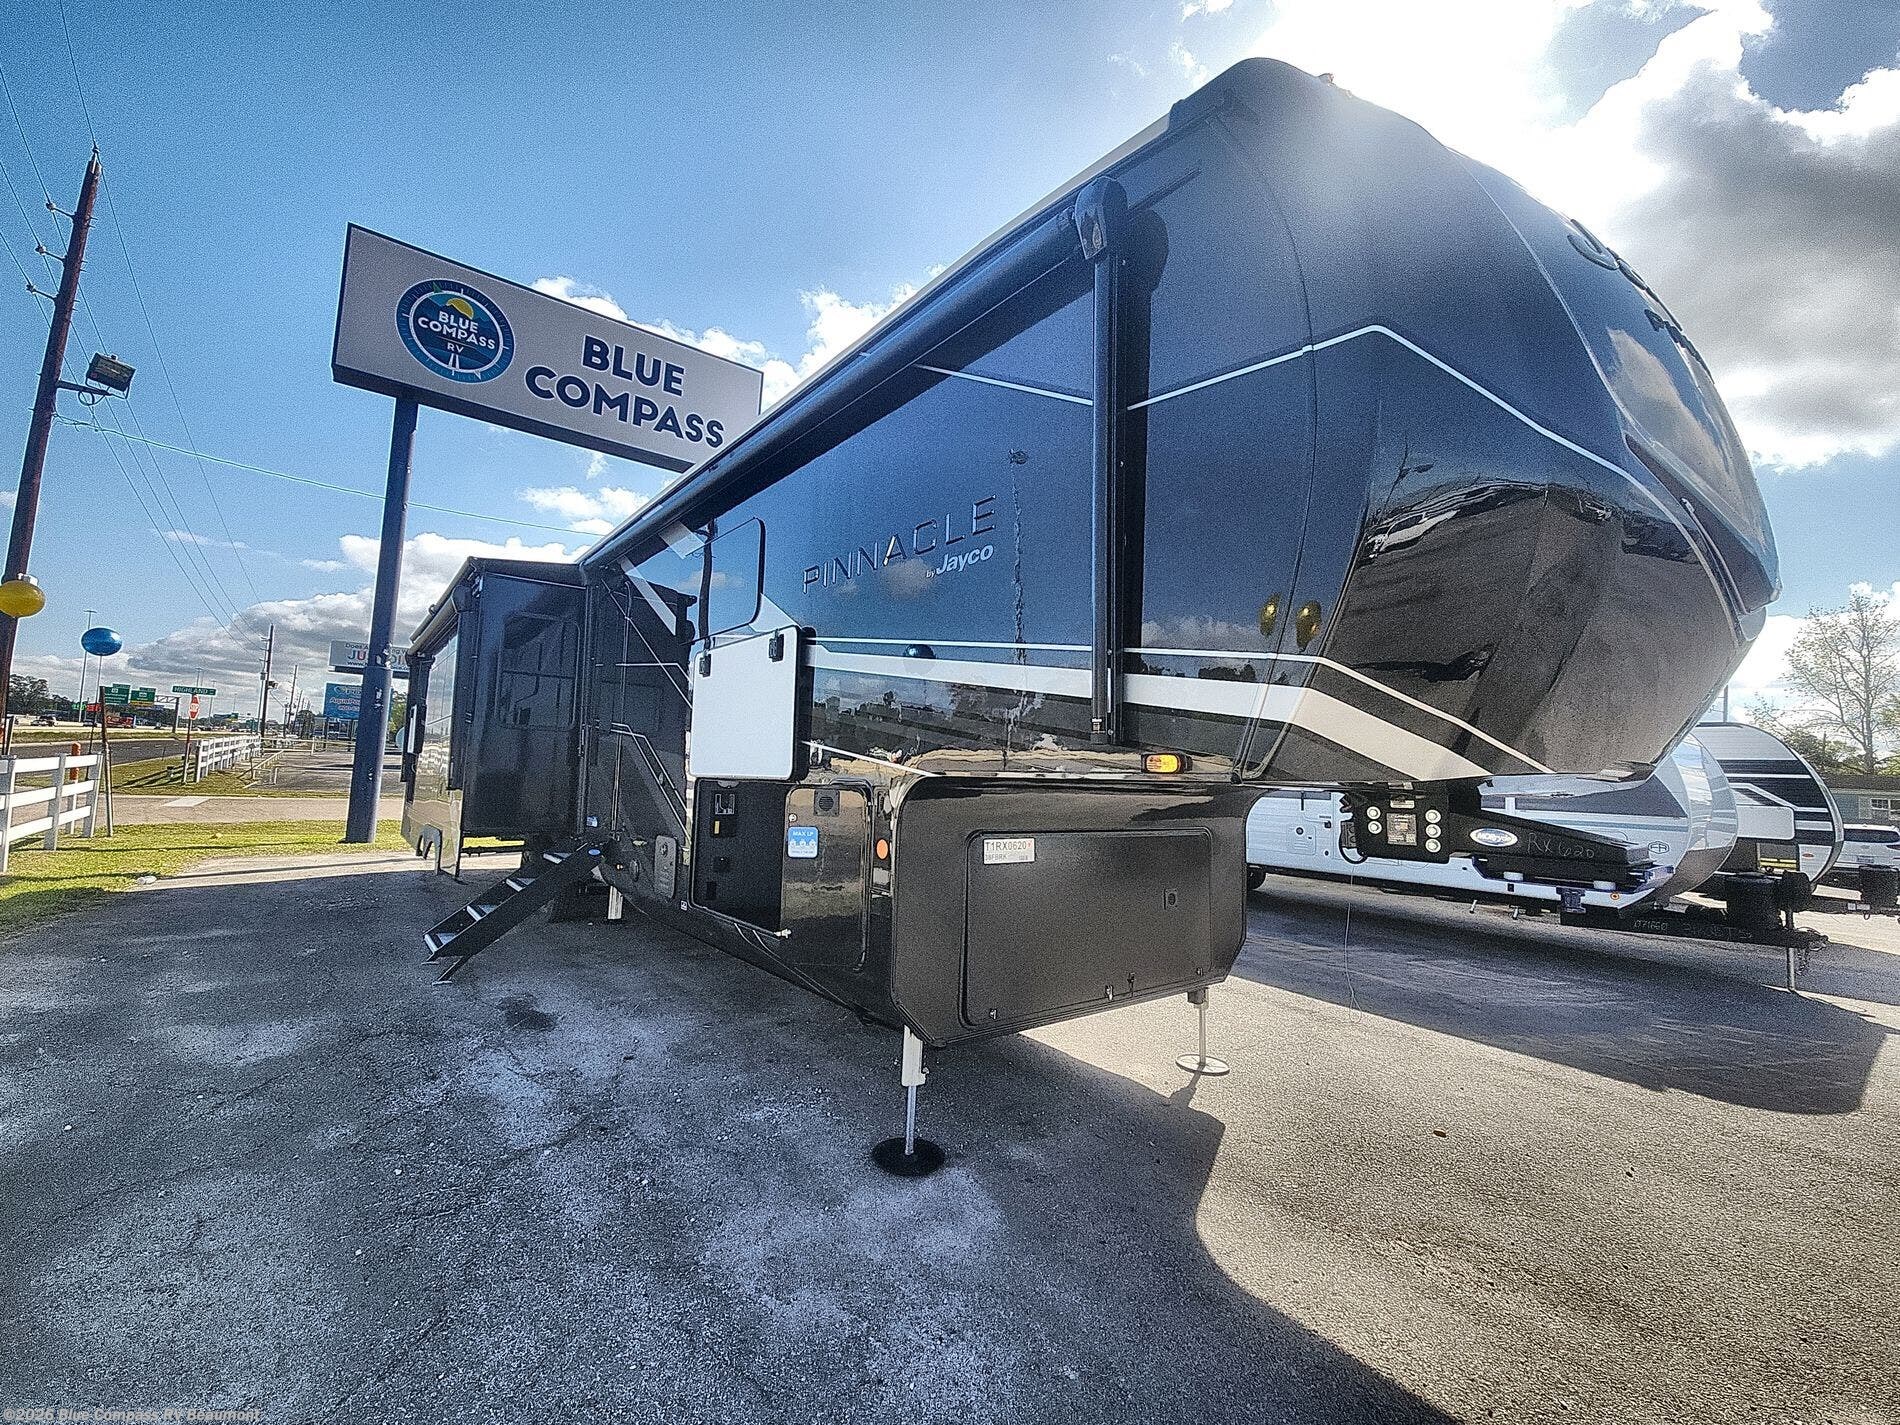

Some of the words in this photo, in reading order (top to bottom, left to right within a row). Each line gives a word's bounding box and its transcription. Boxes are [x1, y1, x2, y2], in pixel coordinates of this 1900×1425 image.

[418, 317, 496, 350] COMPASS
[439, 311, 479, 333] BLUE
[447, 342, 464, 354] RV
[582, 334, 685, 397] BLUE
[525, 365, 725, 448] COMPASS
[803, 494, 996, 595] PINNACLE
[936, 545, 995, 576] Jayco
[985, 840, 1027, 851] T1RX0620
